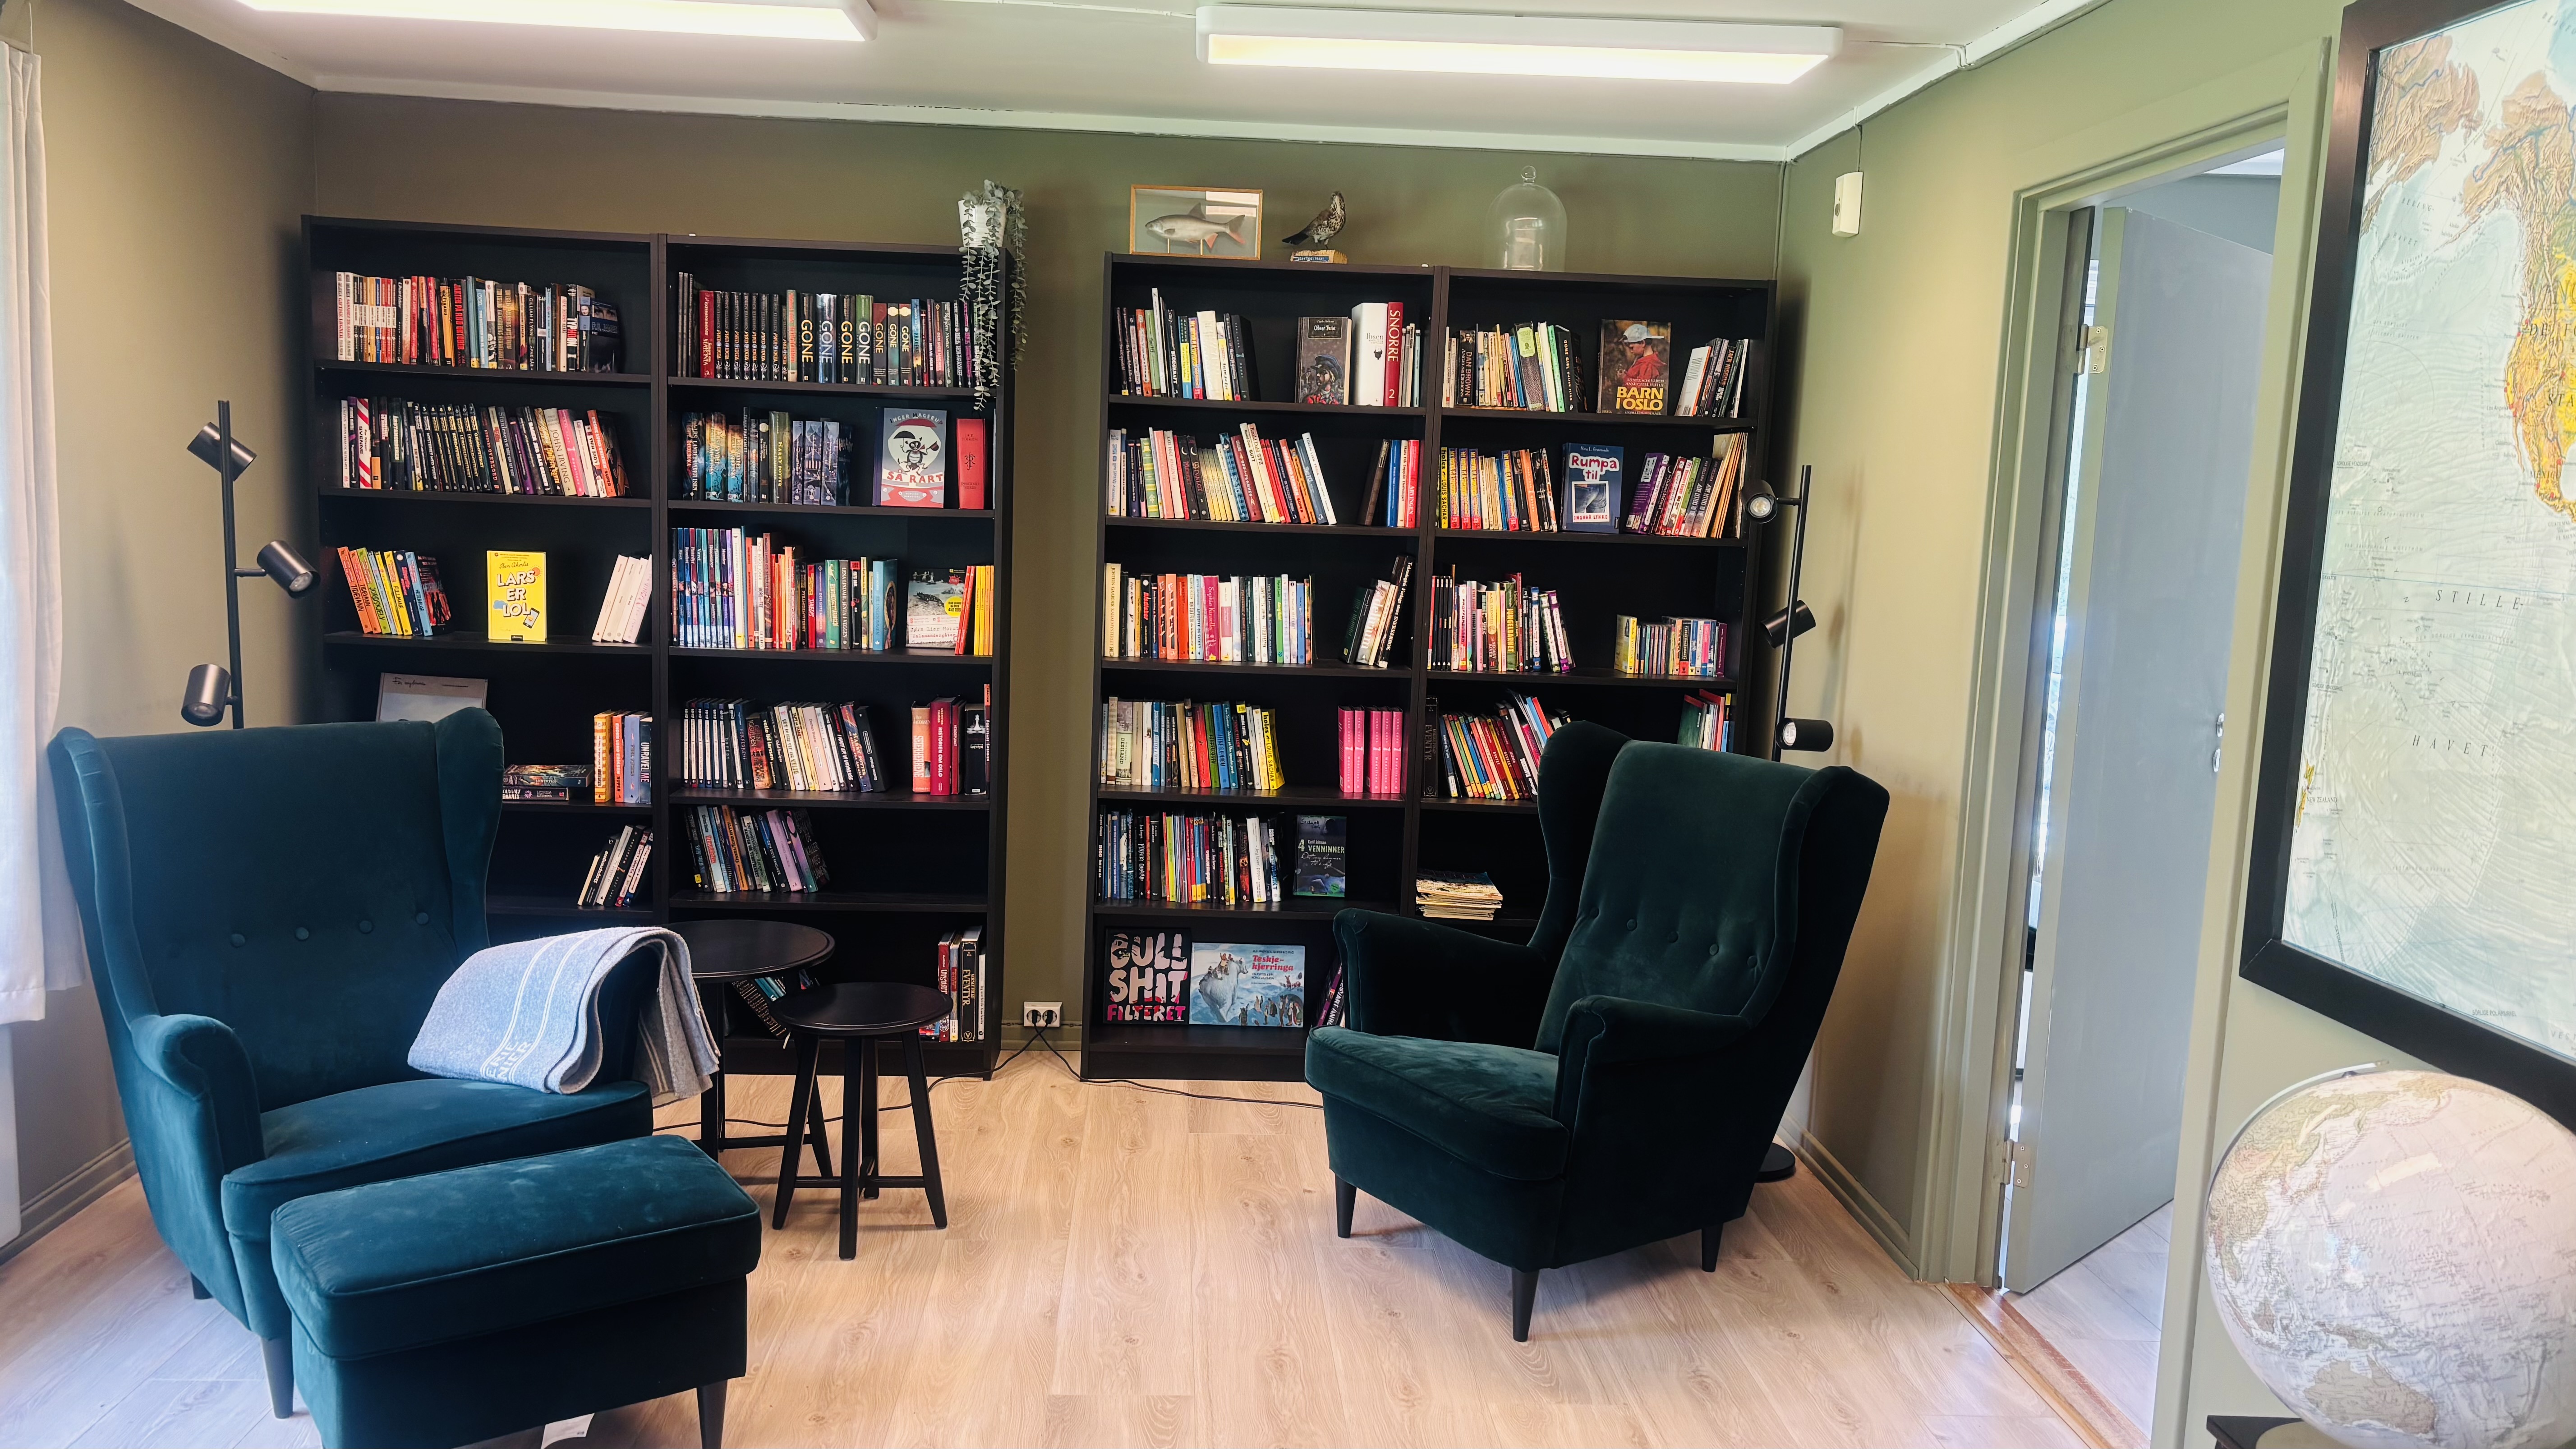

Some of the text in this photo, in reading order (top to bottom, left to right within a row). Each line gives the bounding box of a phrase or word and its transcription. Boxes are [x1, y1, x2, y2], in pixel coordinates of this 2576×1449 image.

[567, 317, 577, 347] TYPHOON
[801, 319, 814, 363] GONE
[821, 320, 833, 364] GONE
[841, 321, 853, 364] GONE
[859, 321, 870, 364] GONE
[875, 323, 884, 354] GONE
[1388, 309, 1400, 399] SNORRE 2
[1726, 349, 1734, 363] JACK
[1617, 386, 1664, 399] BARN
[1616, 398, 1664, 411] I OSLO
[889, 412, 943, 425] INGER HAGERUP
[487, 449, 498, 481] OVERLORD
[549, 429, 562, 451] JOHN
[556, 454, 570, 483] IRVING
[1571, 455, 1617, 472] Rumpa
[887, 469, 943, 483] SÅ RART
[1585, 469, 1598, 479] til
[497, 569, 536, 587] LARS
[350, 584, 364, 612] TIDEVANN
[359, 584, 371, 607] TIDEVANN
[506, 587, 526, 602] ER
[503, 603, 531, 617] LOL
[1206, 586, 1215, 631] Sophie Kinsella
[766, 741, 775, 761] larssen
[913, 735, 924, 778] SEIERHERRENE
[2412, 735, 2489, 757] HAVET
[640, 742, 650, 783] UNRAVEL ME
[938, 754, 943, 764] OM
[1298, 839, 1345, 854] 4 VENNINNER
[1110, 932, 1187, 970] BULL
[1251, 955, 1284, 964] Teskje-
[1251, 962, 1293, 972] kjerringa
[962, 970, 971, 1006] EVENTYR
[1109, 966, 1187, 1004] SHIT
[1106, 1005, 1186, 1021] FILTERET
